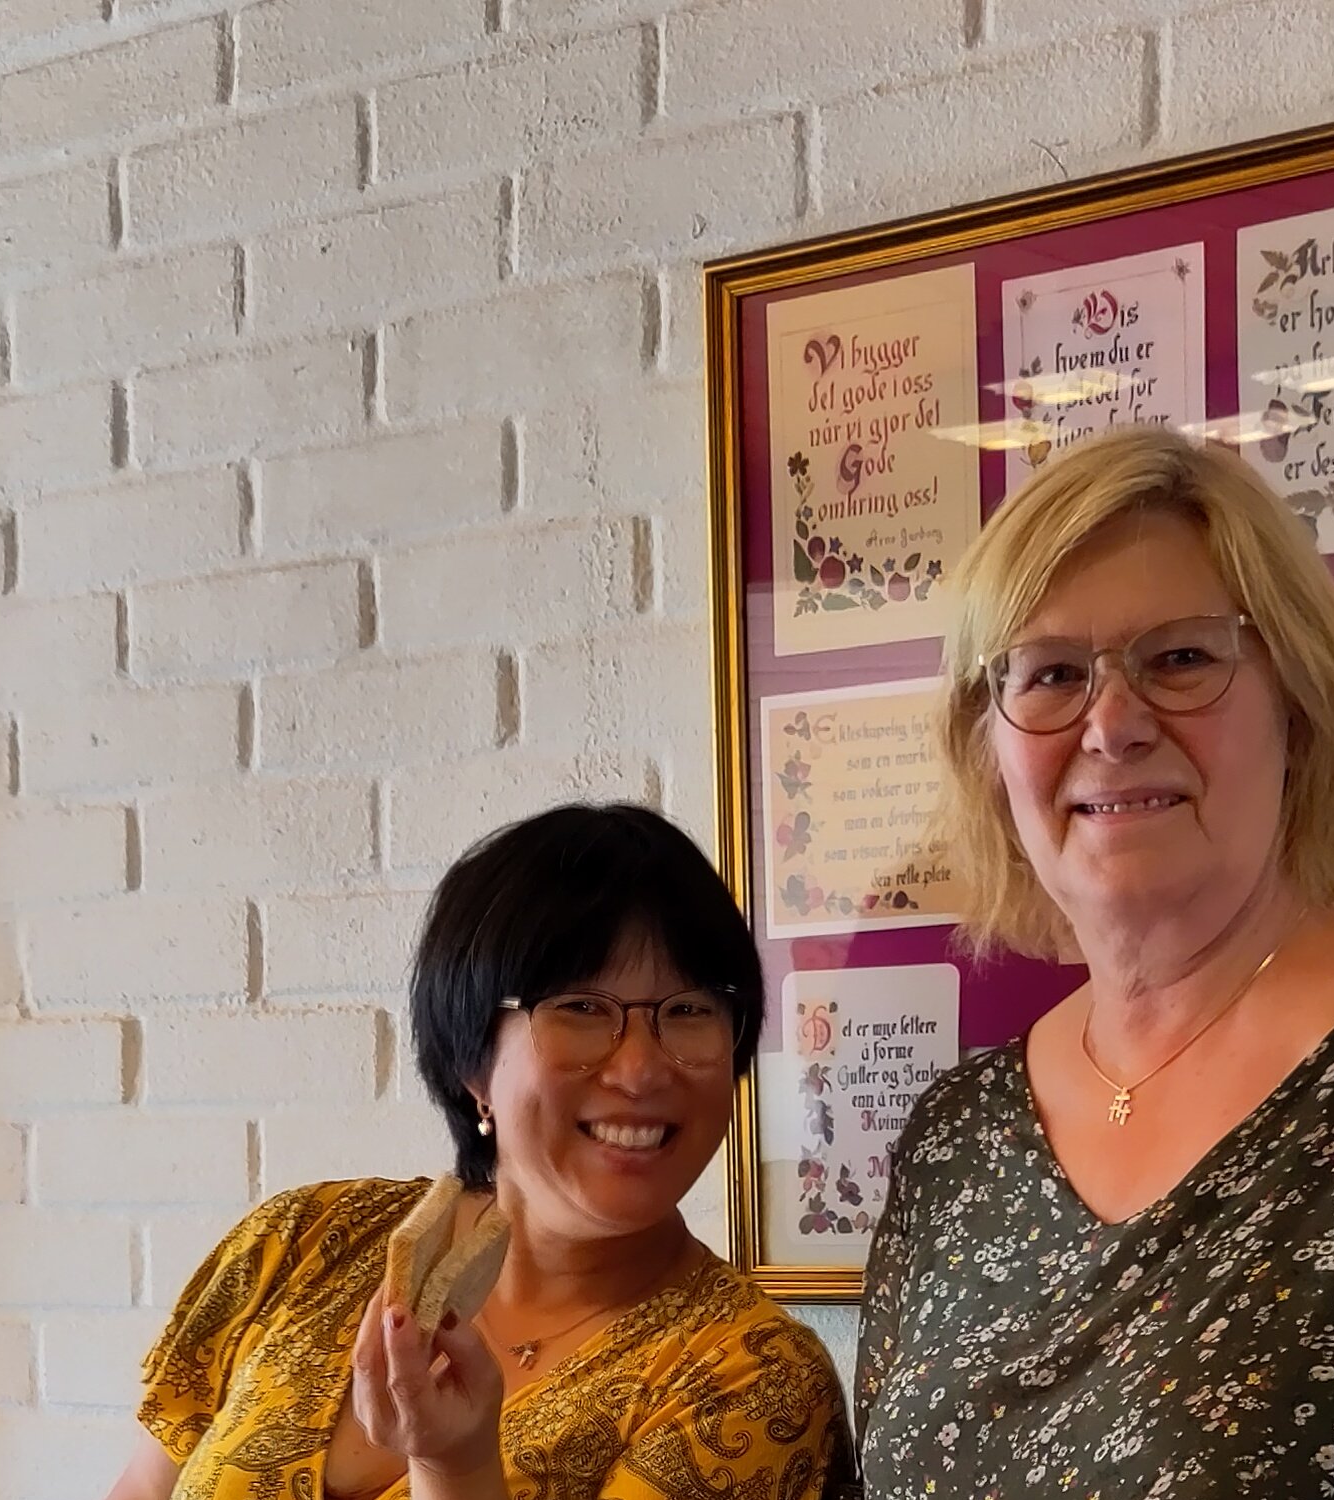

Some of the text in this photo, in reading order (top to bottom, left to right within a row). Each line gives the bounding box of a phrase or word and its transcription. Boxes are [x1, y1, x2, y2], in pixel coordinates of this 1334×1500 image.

[1279, 309, 1302, 333] er
[803, 334, 920, 377] Vi bygger
[1055, 332, 1155, 374] hvem du er
[808, 380, 835, 413] det
[841, 372, 888, 414] gode
[902, 372, 933, 395] oss
[846, 417, 862, 441] vi
[914, 397, 940, 430] det
[838, 444, 896, 497] Gode
[1283, 459, 1306, 481] er
[818, 475, 939, 522] omkring oss!
[922, 863, 952, 891] pleie
[856, 1023, 870, 1037] er
[872, 1022, 897, 1041] mye
[900, 1014, 938, 1035] lettere
[861, 1041, 915, 1067] å forme
[837, 1060, 947, 1091] Gutter og Jente
[851, 1094, 875, 1109] enn
[877, 1091, 886, 1108] å
[860, 1109, 908, 1132] Kvinn
